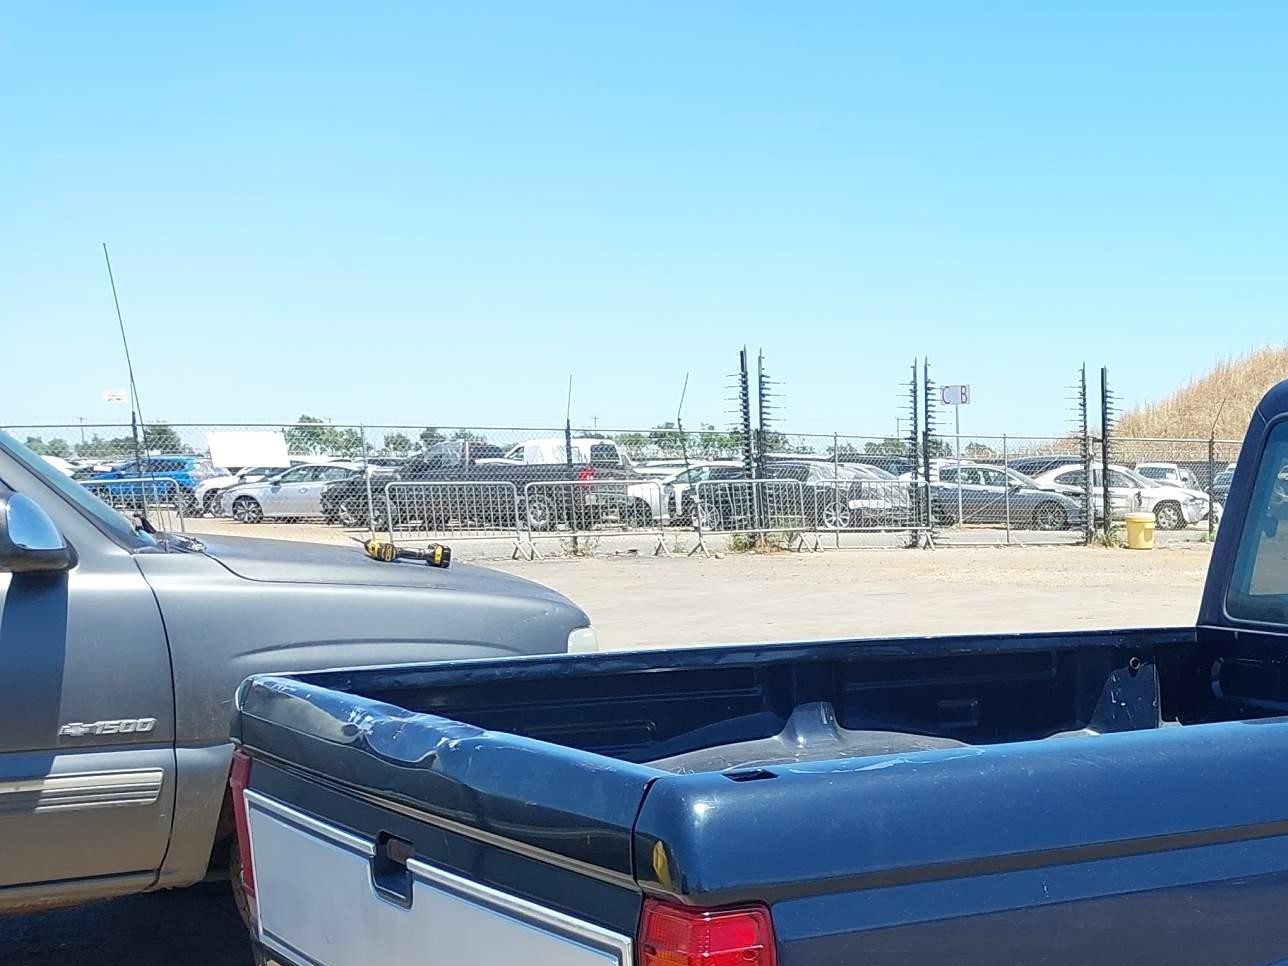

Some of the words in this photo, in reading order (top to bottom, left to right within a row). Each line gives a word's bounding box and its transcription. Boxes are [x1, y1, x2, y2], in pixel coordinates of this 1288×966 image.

[942, 385, 951, 405] C
[960, 385, 968, 404] B
[94, 718, 157, 735] 1500
